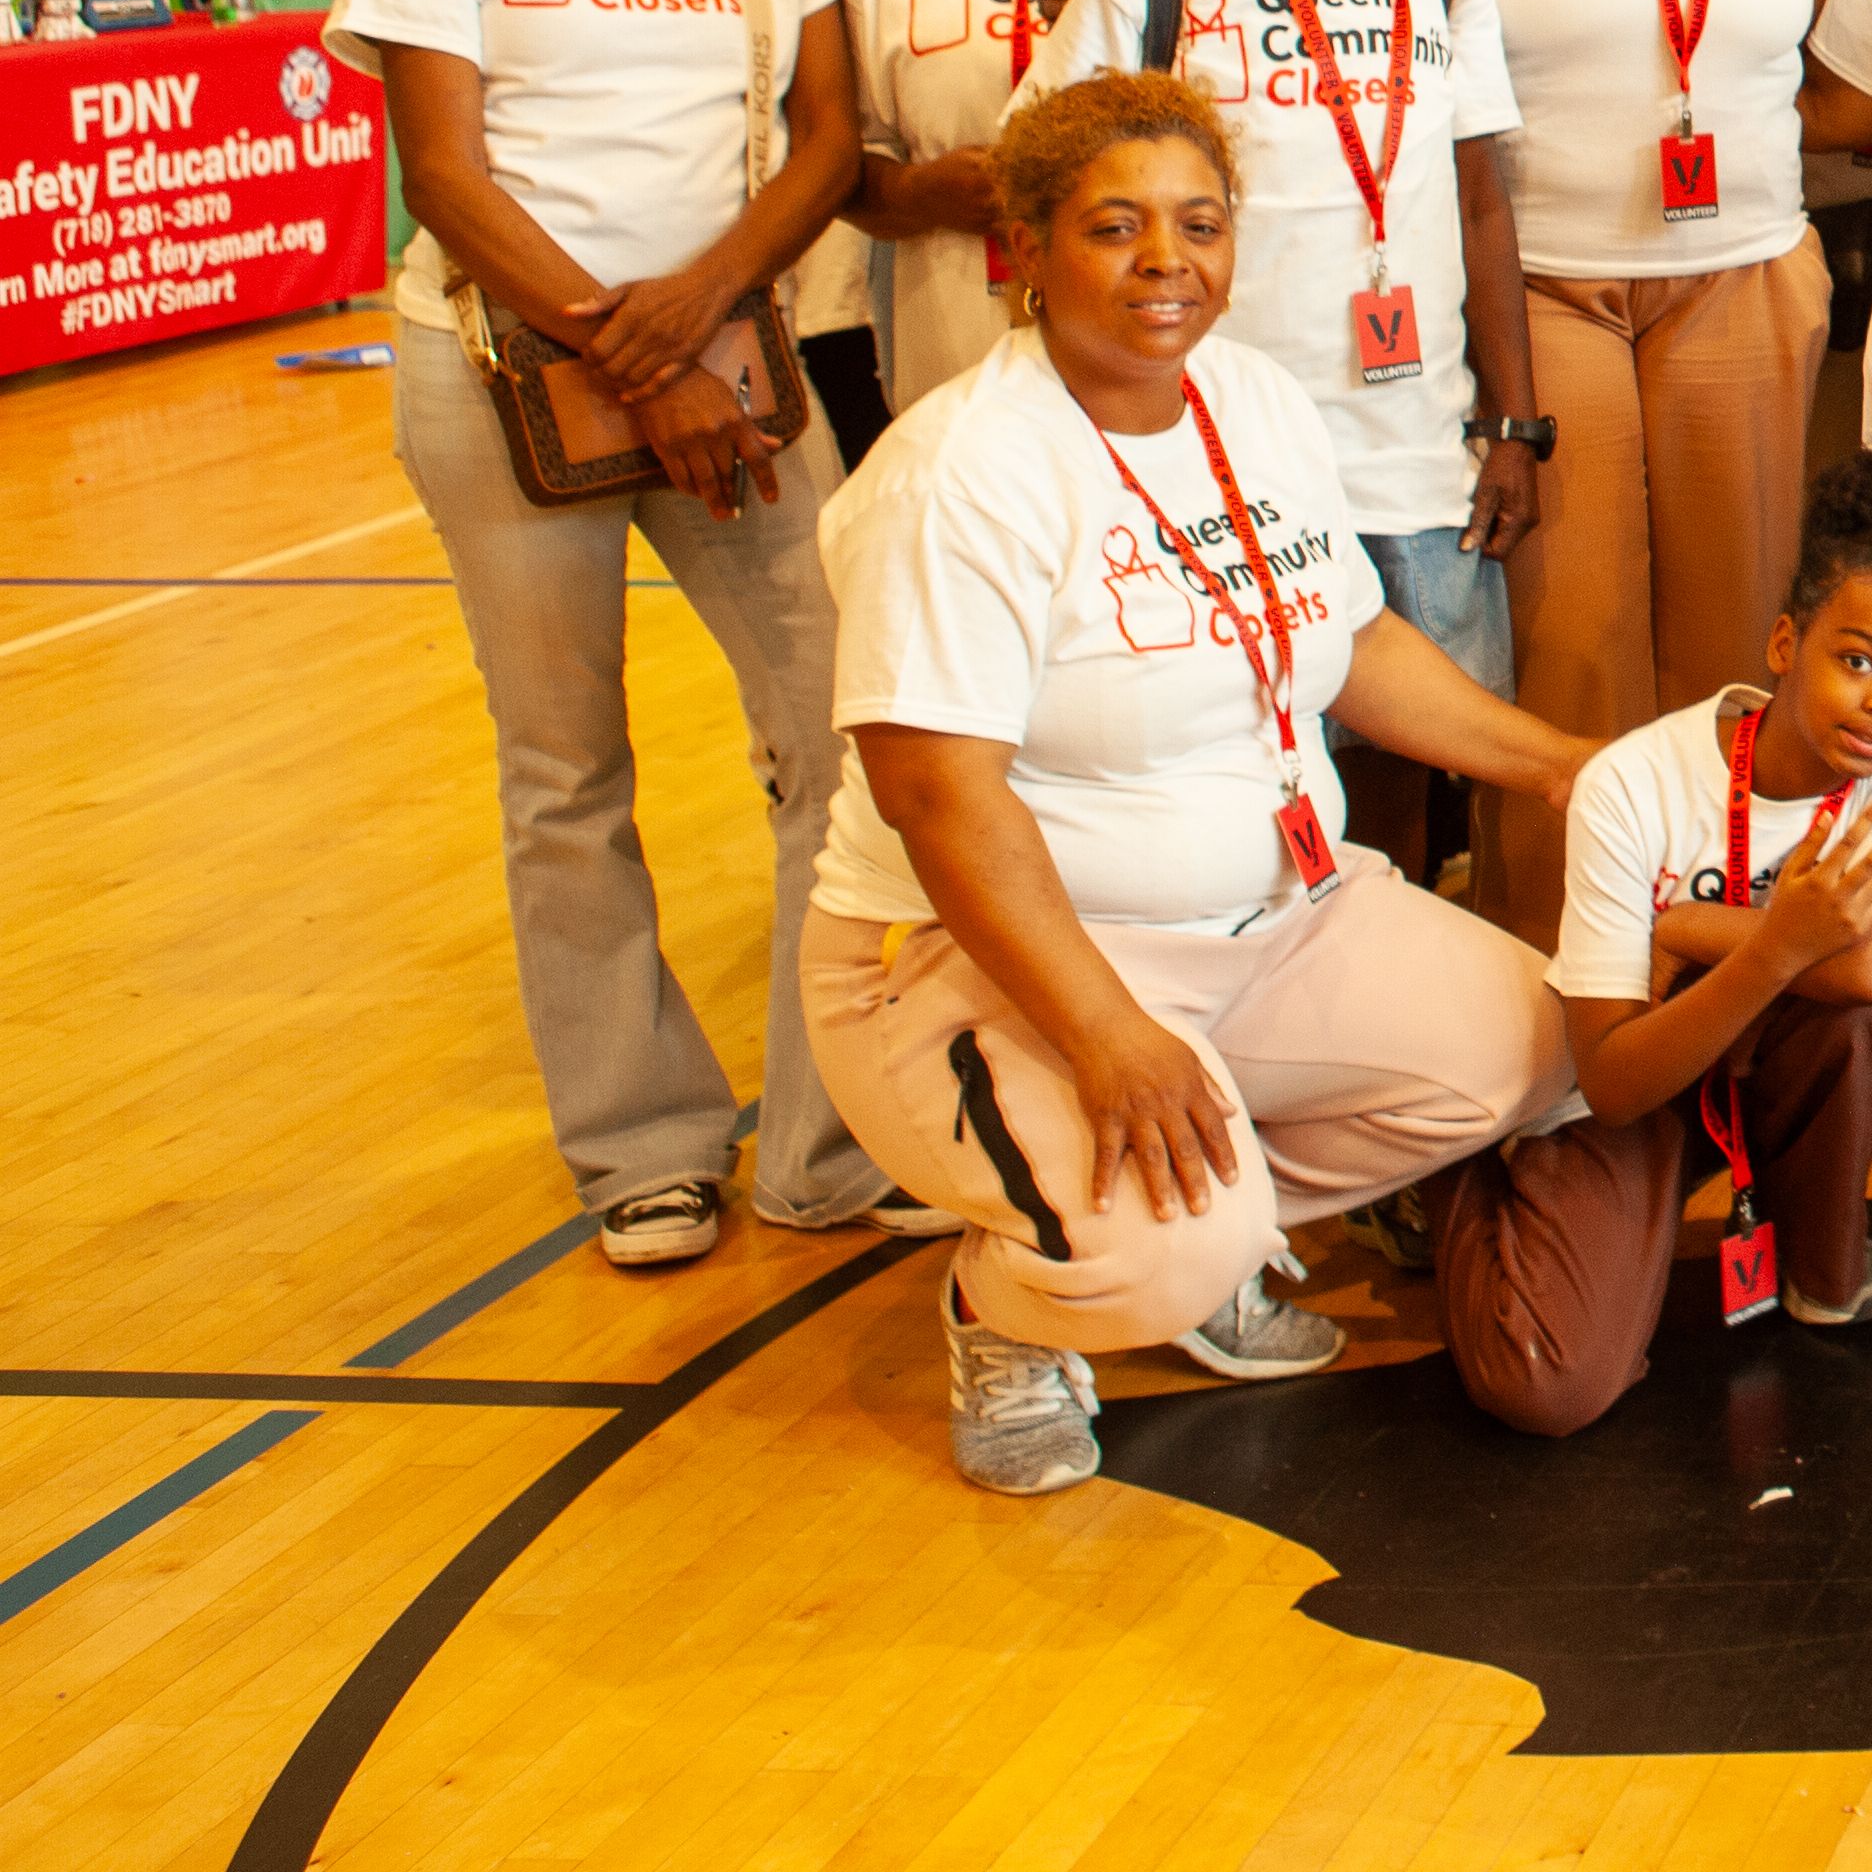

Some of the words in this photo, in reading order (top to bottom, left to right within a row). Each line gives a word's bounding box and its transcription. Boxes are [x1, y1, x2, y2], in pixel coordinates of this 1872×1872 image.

[71, 73, 199, 144] FDNY
[752, 33, 771, 116] KORS
[0, 160, 98, 219] afety
[105, 127, 295, 198] Education
[302, 111, 372, 168] Unit
[53, 210, 113, 257] (718)
[1664, 204, 1719, 222] VOLUNTEER
[33, 258, 104, 299] More
[109, 246, 141, 283] at
[148, 218, 327, 277] fdnysmart.org
[1363, 362, 1422, 382] VOLUNTEER
[1226, 490, 1270, 583] VOLUNTEER
